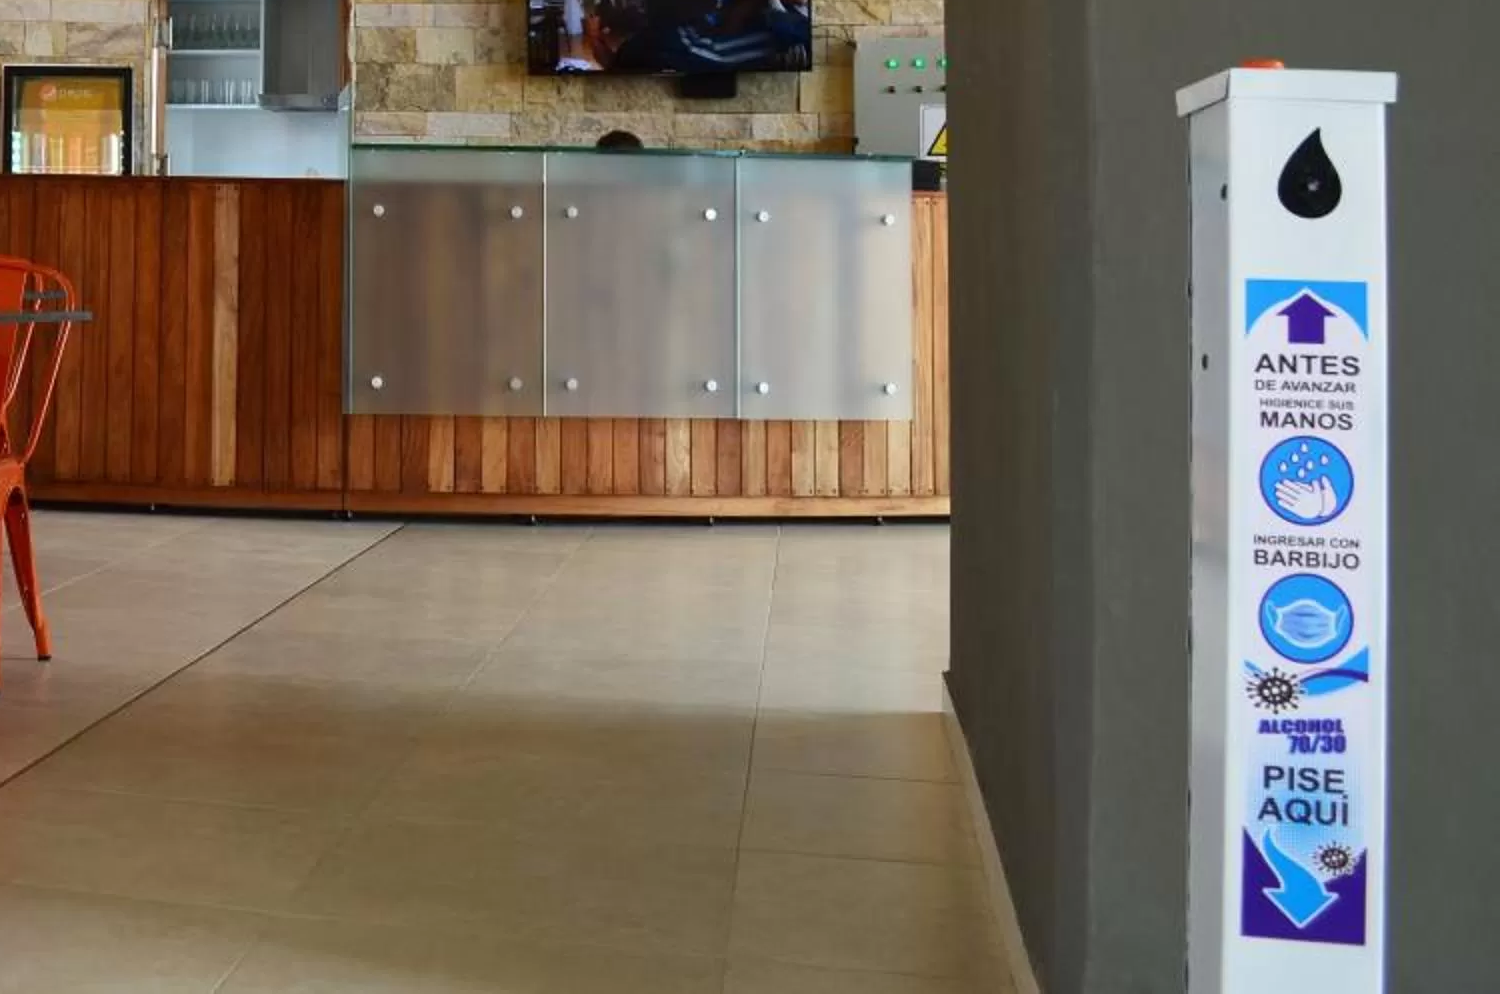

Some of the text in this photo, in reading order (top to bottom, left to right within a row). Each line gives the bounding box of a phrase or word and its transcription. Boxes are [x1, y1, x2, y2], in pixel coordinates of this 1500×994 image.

[1254, 353, 1361, 376] ANTES
[1254, 379, 1356, 393] DE AVANZAR
[1260, 397, 1355, 411] HIGIENICE SUS
[1260, 410, 1354, 431] MANOS
[1253, 534, 1360, 549] INGRESAR CON
[1253, 548, 1360, 570] BARBIJO
[1258, 718, 1345, 735] ALCOHOL
[1288, 734, 1347, 754] 70/30
[1263, 765, 1345, 794] PISE
